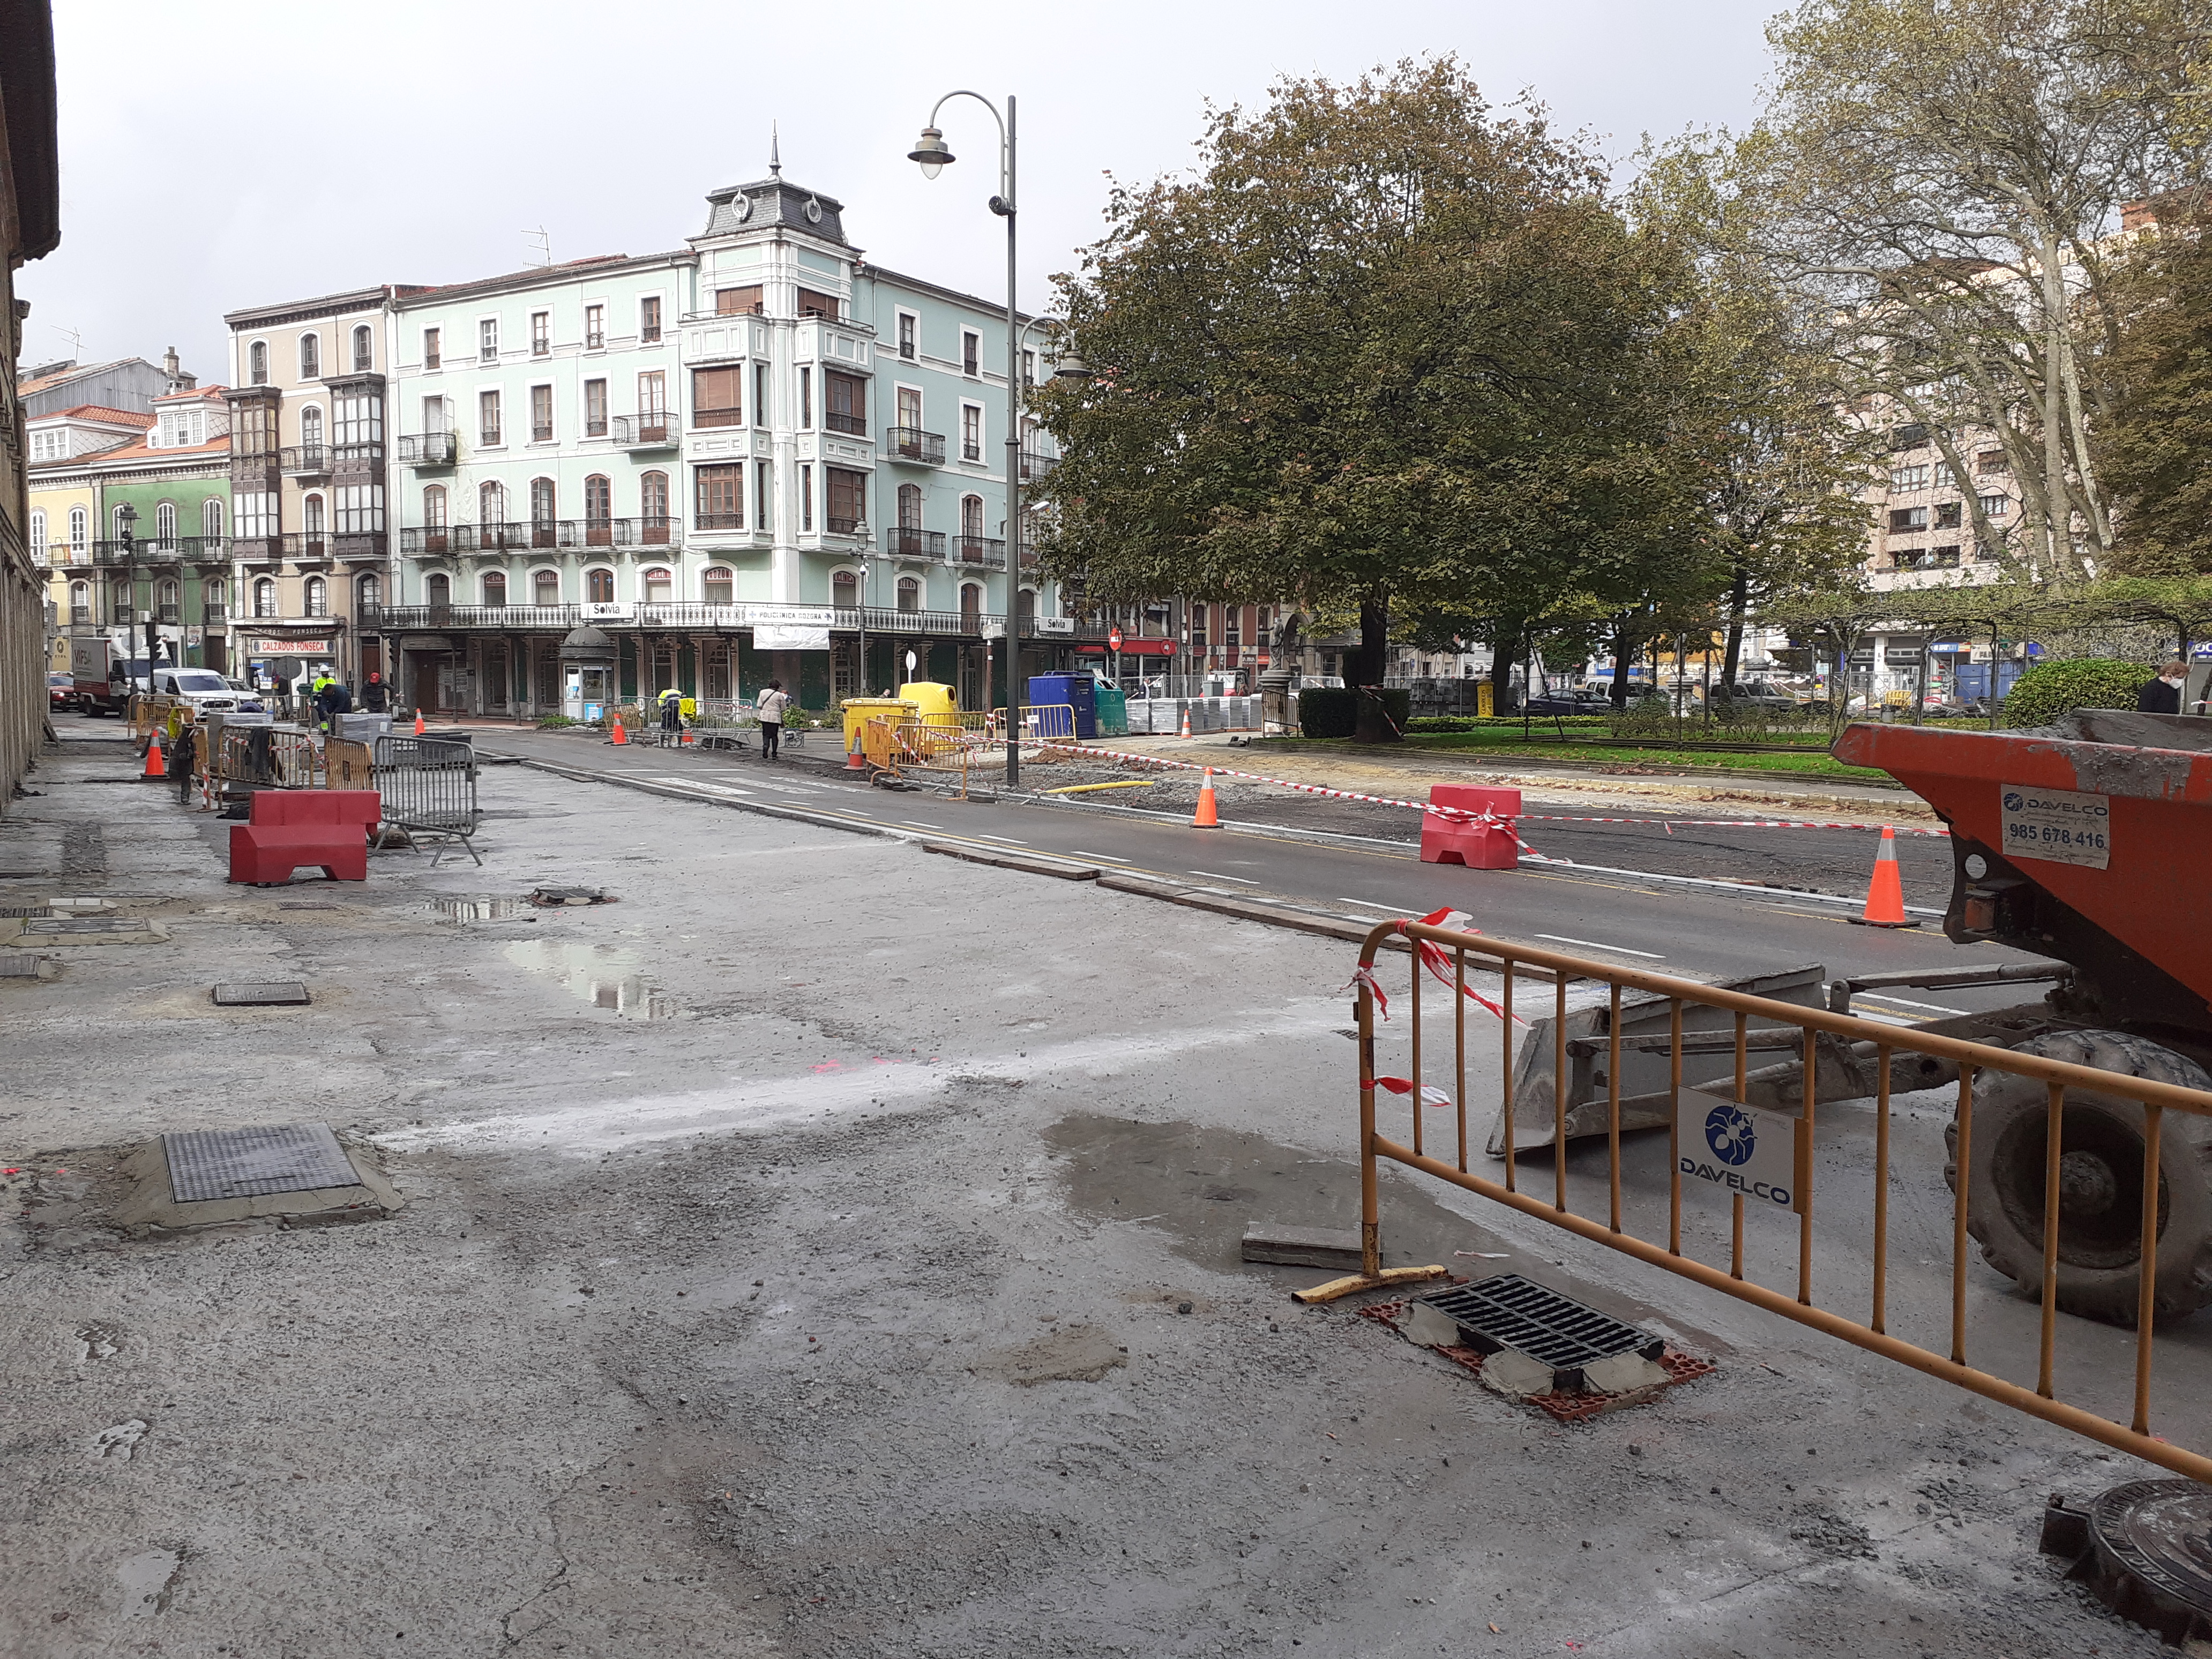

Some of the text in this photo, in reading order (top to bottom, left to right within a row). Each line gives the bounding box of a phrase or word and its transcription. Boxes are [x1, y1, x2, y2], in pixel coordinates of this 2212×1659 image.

[594, 603, 621, 615] Solvia
[1048, 618, 1066, 629] Solvia
[262, 641, 295, 651] CALZADOS
[297, 641, 325, 651] FONSECA
[2027, 799, 2108, 816] DAVELCO
[2010, 823, 2105, 849] 985 678 416
[1680, 1157, 1791, 1205] DAVELCO
